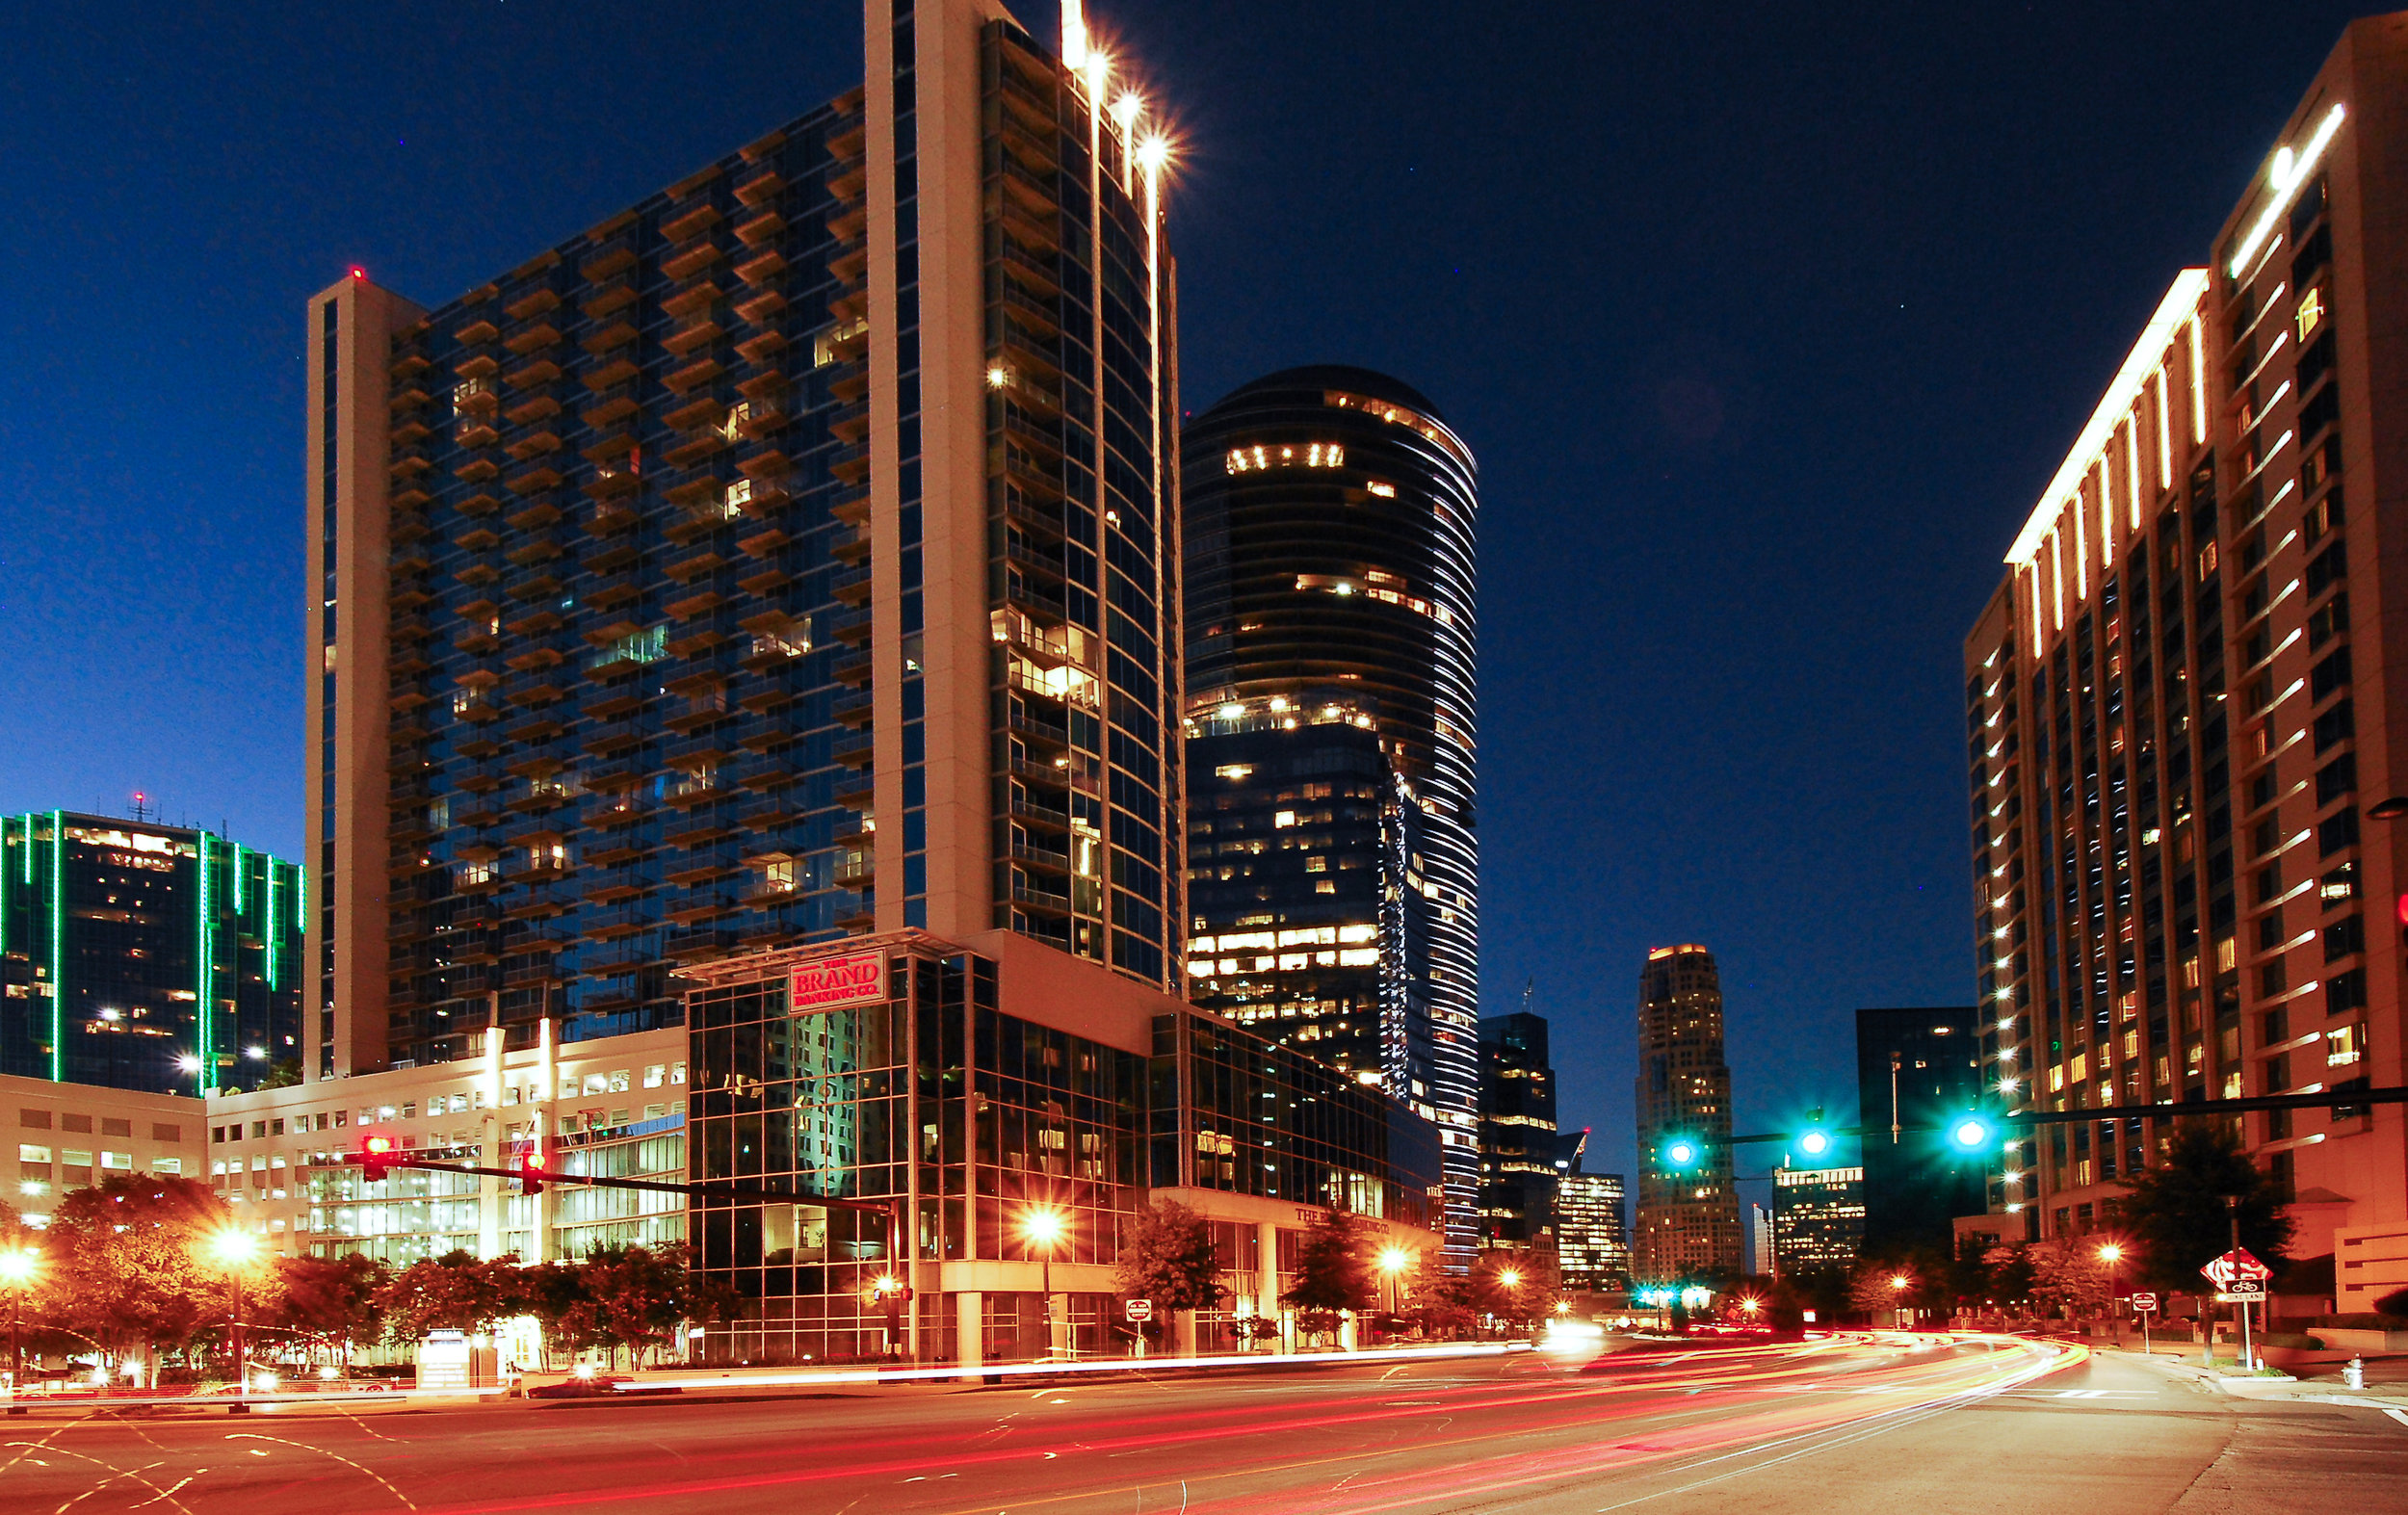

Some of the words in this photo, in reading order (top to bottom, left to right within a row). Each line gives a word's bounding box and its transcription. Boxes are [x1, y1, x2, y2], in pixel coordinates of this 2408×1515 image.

[822, 957, 848, 969] THE
[793, 963, 877, 994] BRAND
[794, 986, 854, 1006] BANKING
[855, 983, 879, 997] CO.
[1295, 1208, 1319, 1223] THE
